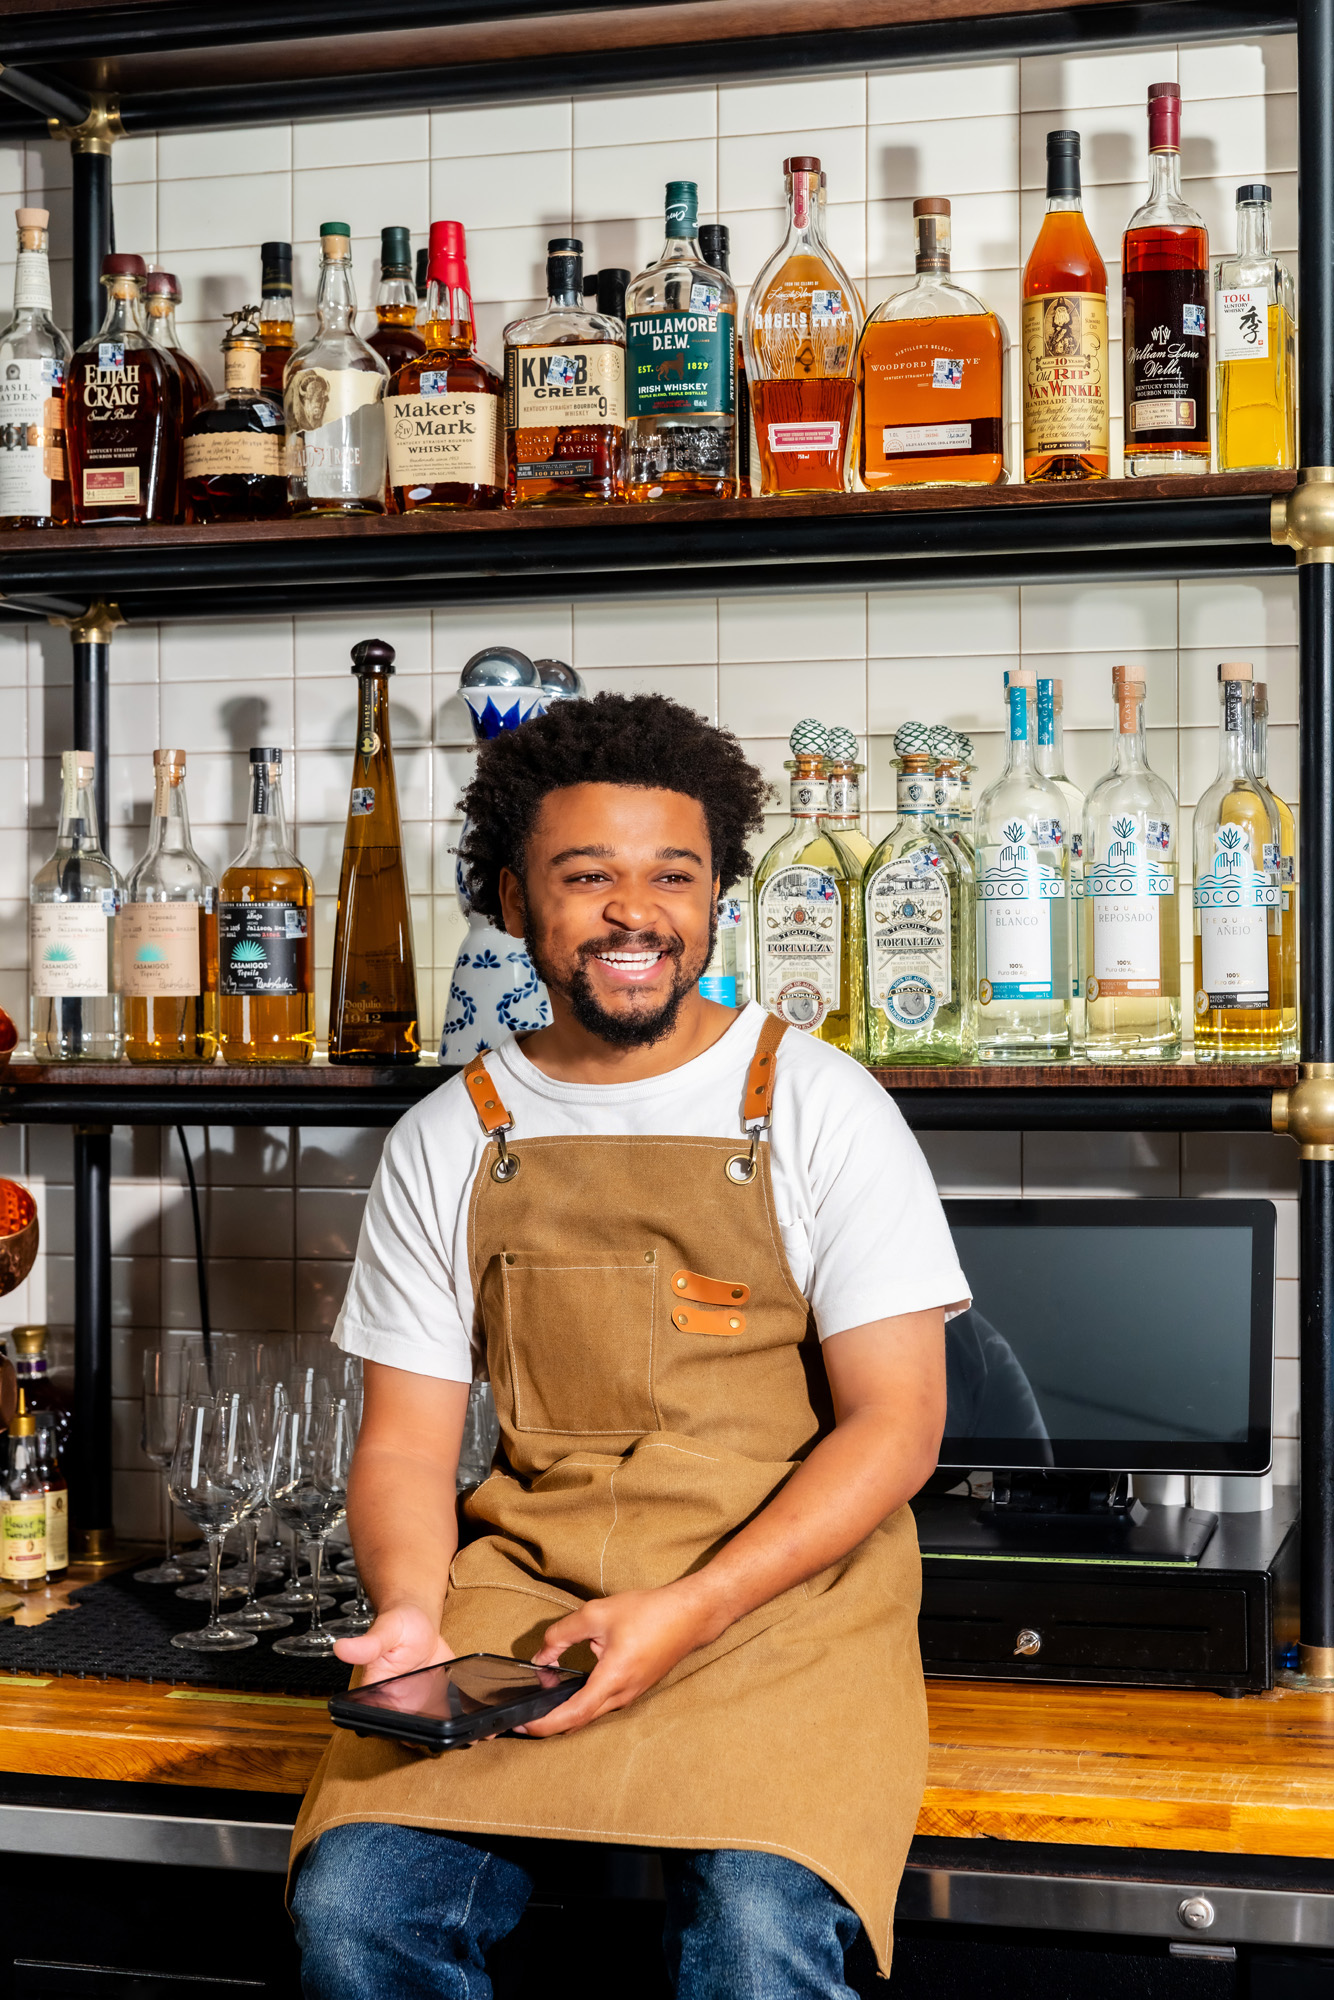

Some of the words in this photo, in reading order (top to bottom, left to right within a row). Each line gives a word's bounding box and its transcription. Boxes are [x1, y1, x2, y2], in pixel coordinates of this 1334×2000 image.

[1223, 294, 1251, 303] TOKI
[630, 316, 717, 337] TULLAMORE
[1239, 306, 1262, 344] 季
[653, 334, 690, 351] D.E.W.
[895, 345, 928, 357] DISTILLER'S
[930, 344, 953, 352] SELECT
[1128, 343, 1166, 364] William
[566, 360, 577, 369] TX
[687, 362, 709, 370] 1829
[871, 361, 927, 372] WOODFORD
[949, 361, 961, 369] TX
[1055, 358, 1067, 366] 10
[522, 355, 588, 388] KNB
[638, 365, 654, 374] EST.
[84, 364, 140, 388] ELIJAH
[1036, 371, 1052, 382] Old
[1054, 369, 1090, 380] RIP
[534, 386, 602, 398] CREEK
[638, 385, 661, 395] IRISH
[664, 383, 708, 393] WHISKEY
[1028, 383, 1049, 401] VAN
[1048, 380, 1102, 398] WINKLE
[83, 385, 139, 409] CRAIG
[1025, 398, 1067, 408] HANDMADE
[1070, 397, 1105, 405] BOURBON
[393, 401, 476, 418] Maker's
[598, 397, 608, 418] 9
[414, 420, 476, 437] Mark
[408, 445, 462, 454] WHISKY
[327, 447, 361, 466] TRCE
[1230, 697, 1238, 720] CASE
[1052, 821, 1061, 829] TX
[1161, 823, 1170, 833] TX
[979, 882, 1059, 897] SOCORO
[1086, 879, 1168, 893] SOCORO
[730, 900, 739, 908] TX
[995, 917, 1039, 926] BLANCO
[1099, 913, 1153, 923] REPOSADO
[889, 923, 930, 934] TEQUILA
[1216, 925, 1251, 936] AÑEJO
[779, 929, 822, 940] TEQUILA
[768, 944, 834, 952] FORTALEZA
[877, 938, 944, 947] FORTALEZA
[231, 962, 268, 970] CASAMIGOS
[344, 1014, 381, 1024] 1942
